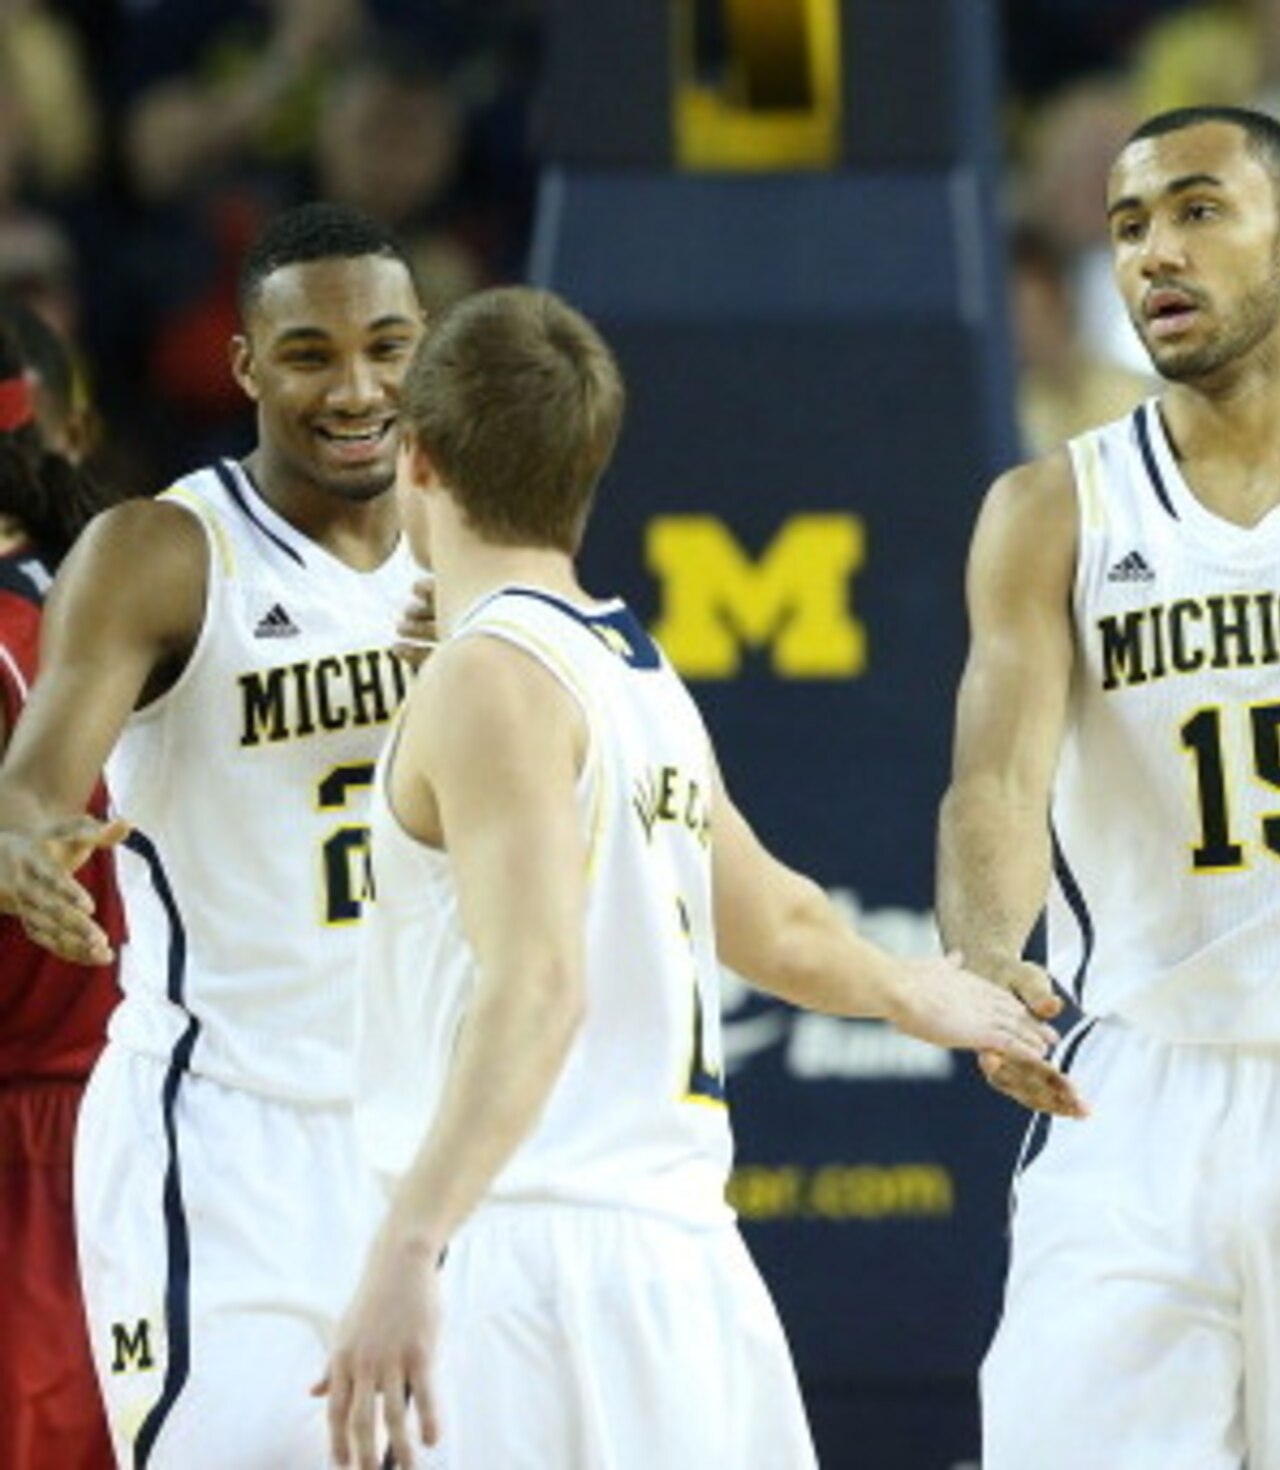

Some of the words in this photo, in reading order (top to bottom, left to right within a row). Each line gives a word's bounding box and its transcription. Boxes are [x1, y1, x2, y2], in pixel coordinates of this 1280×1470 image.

[645, 514, 867, 679] M
[236, 648, 407, 747] MICHI
[727, 1163, 954, 1220] ar.com
[111, 1318, 153, 1373] M
